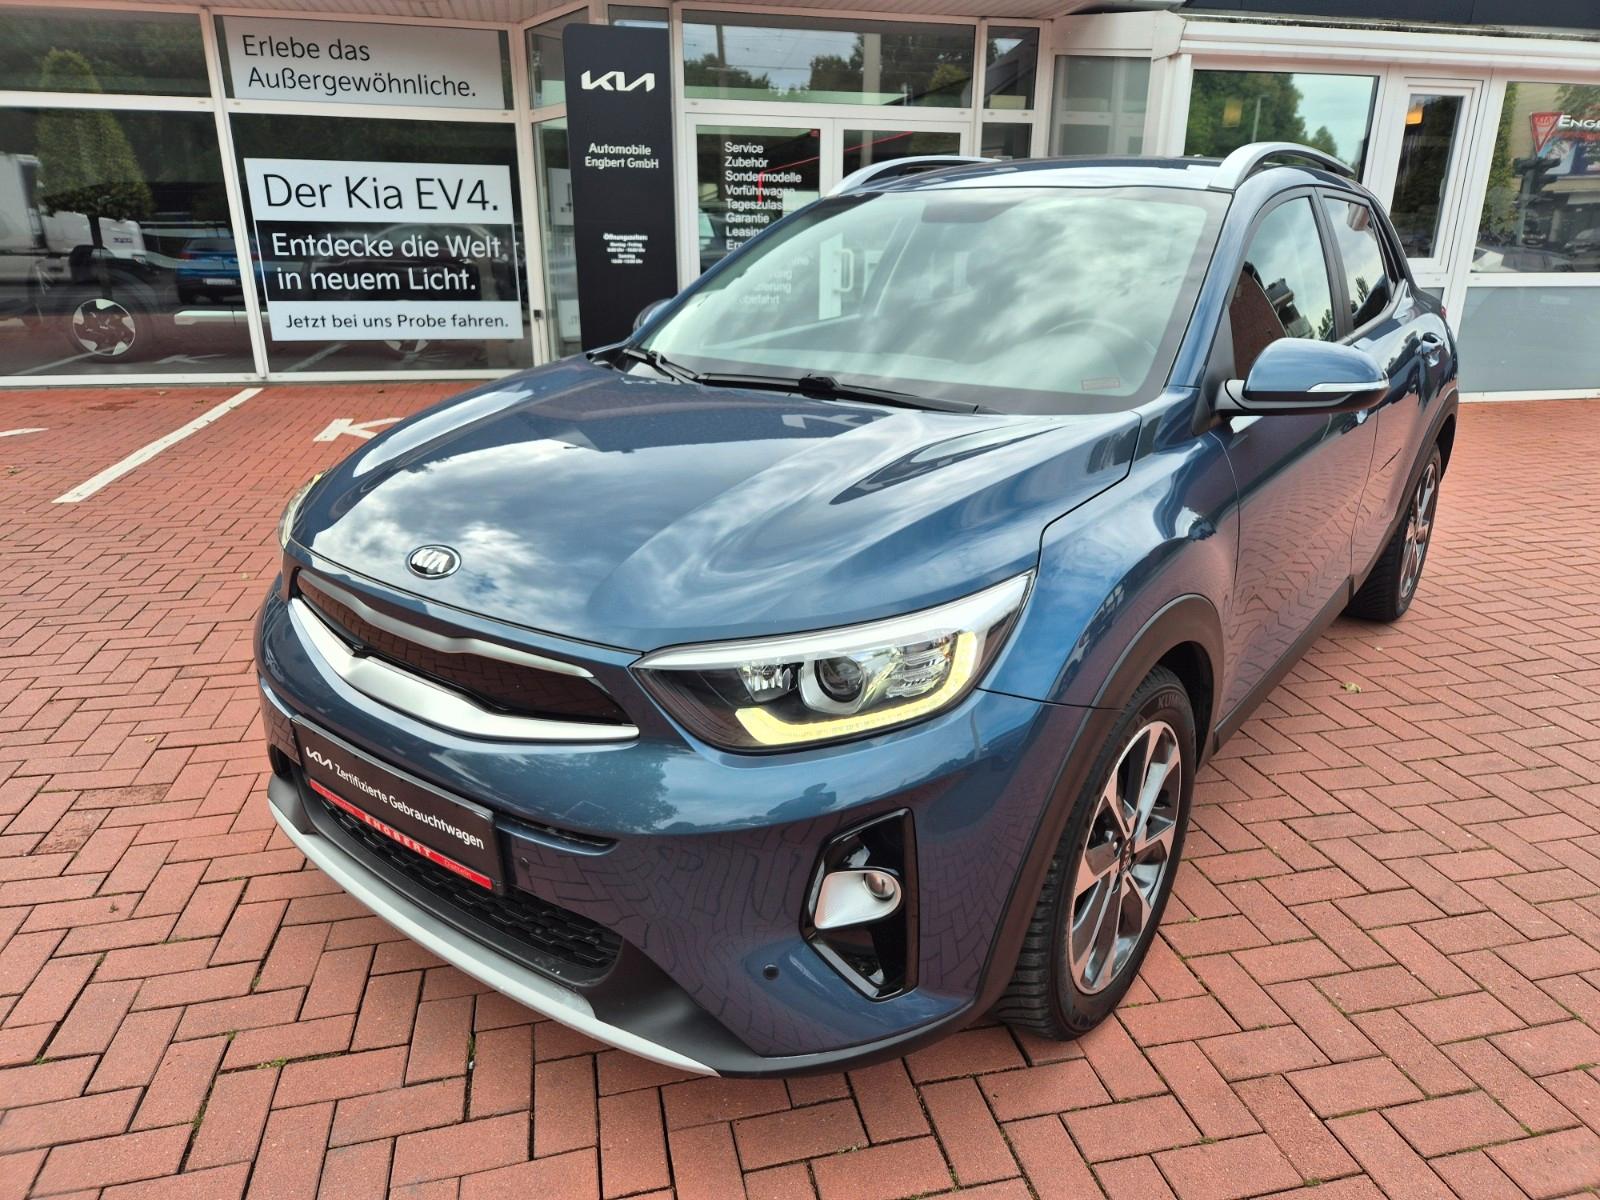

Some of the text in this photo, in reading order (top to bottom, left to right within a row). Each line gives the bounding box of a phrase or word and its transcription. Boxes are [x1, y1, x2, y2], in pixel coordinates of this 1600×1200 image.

[242, 34, 370, 61] Erlebe das
[248, 66, 476, 97] Außergewöhnliche.
[581, 69, 655, 92] KIA
[588, 142, 652, 155] Automobile
[724, 141, 764, 153] Service
[584, 156, 660, 170] Engbert GmbH
[724, 156, 769, 168] Zubehör
[725, 170, 802, 183] Sondermodelle
[263, 173, 498, 211] Der Kia EV4.
[726, 212, 770, 224] Garantie
[272, 232, 394, 258] Entdecke
[400, 234, 439, 258] die
[276, 266, 476, 291] in neuem Licht.
[285, 313, 509, 328] Jetzt bei uns Probe fahren.
[334, 763, 388, 804] Zertifizierte
[389, 795, 485, 850] Gebrauchtwagen
